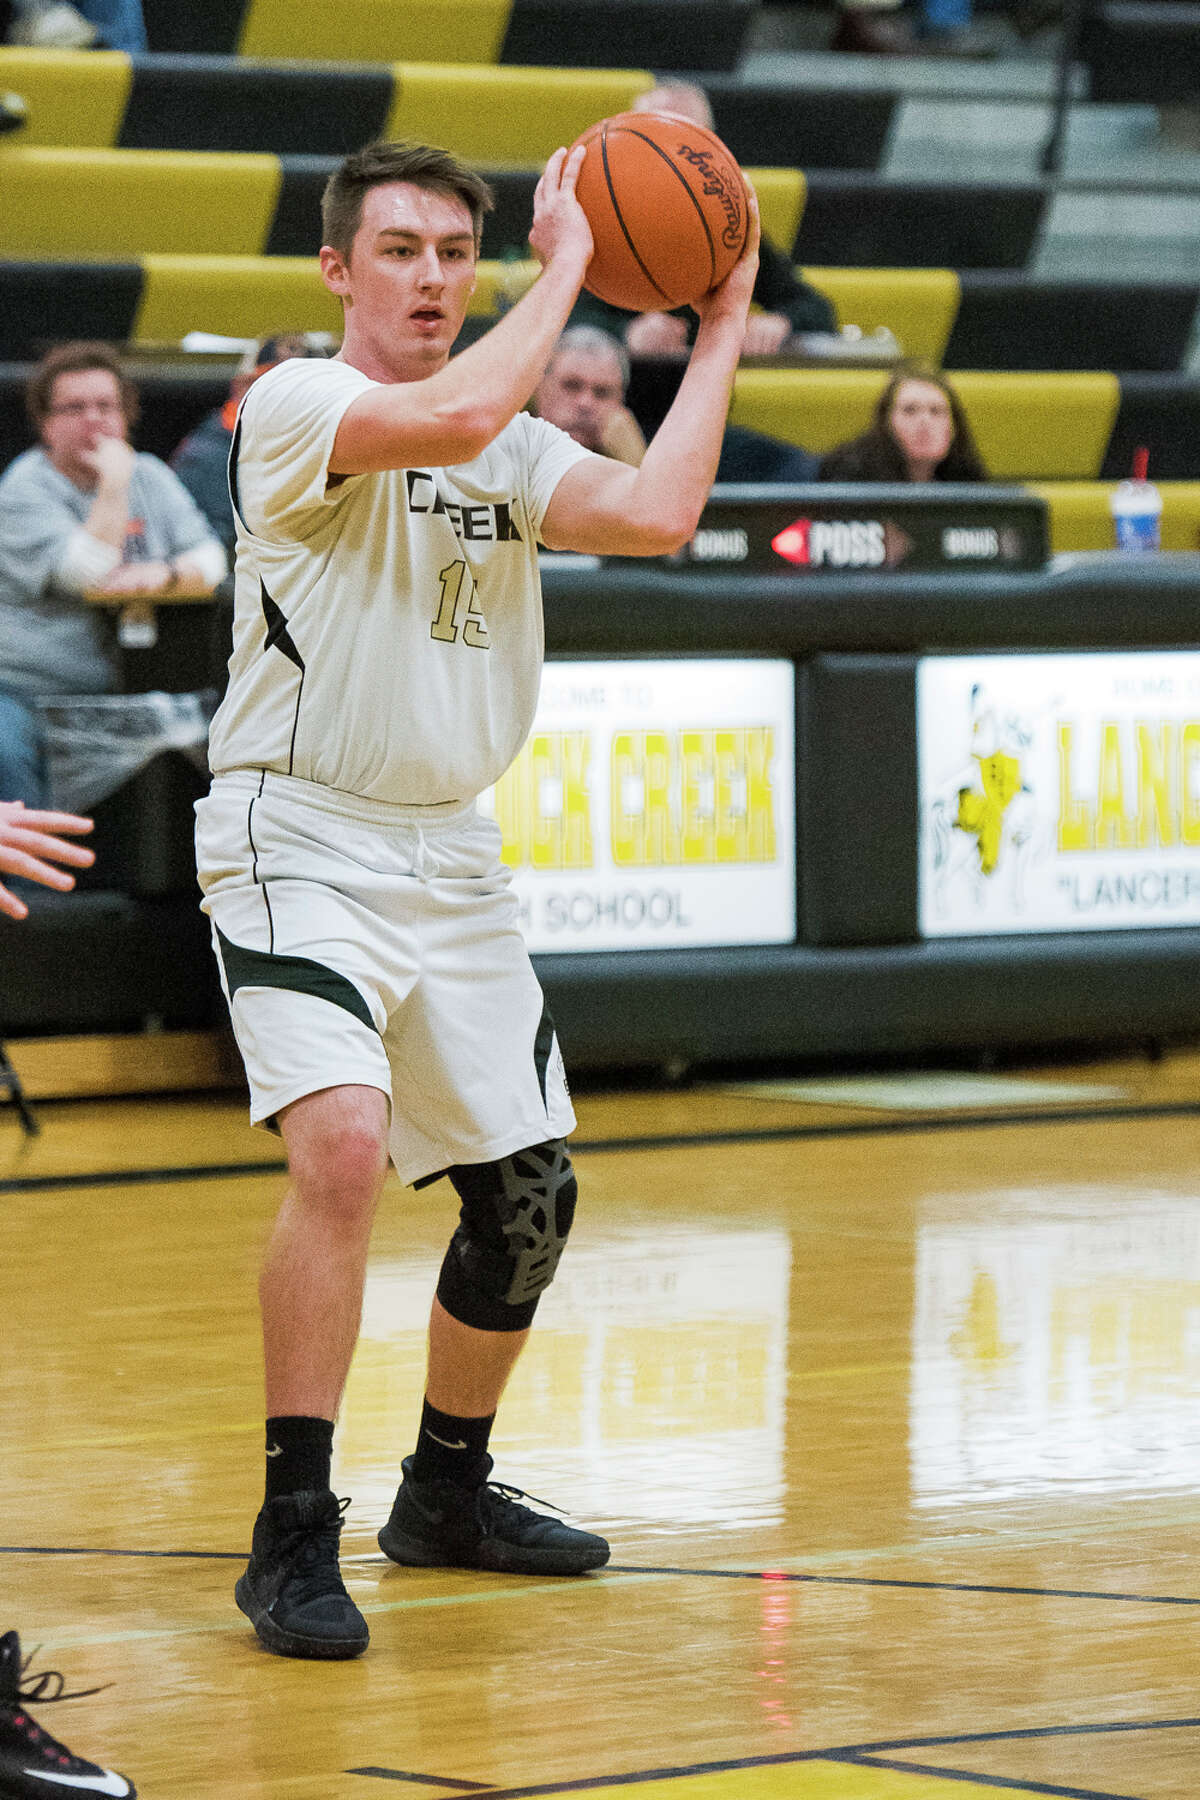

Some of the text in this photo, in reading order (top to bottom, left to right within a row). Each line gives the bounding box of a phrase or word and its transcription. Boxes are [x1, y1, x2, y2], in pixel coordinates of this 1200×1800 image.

[677, 144, 743, 249] Rawlings
[809, 519, 886, 568] POSS
[494, 727, 777, 871] OCK CREEK
[545, 888, 692, 932] SCHOOL
